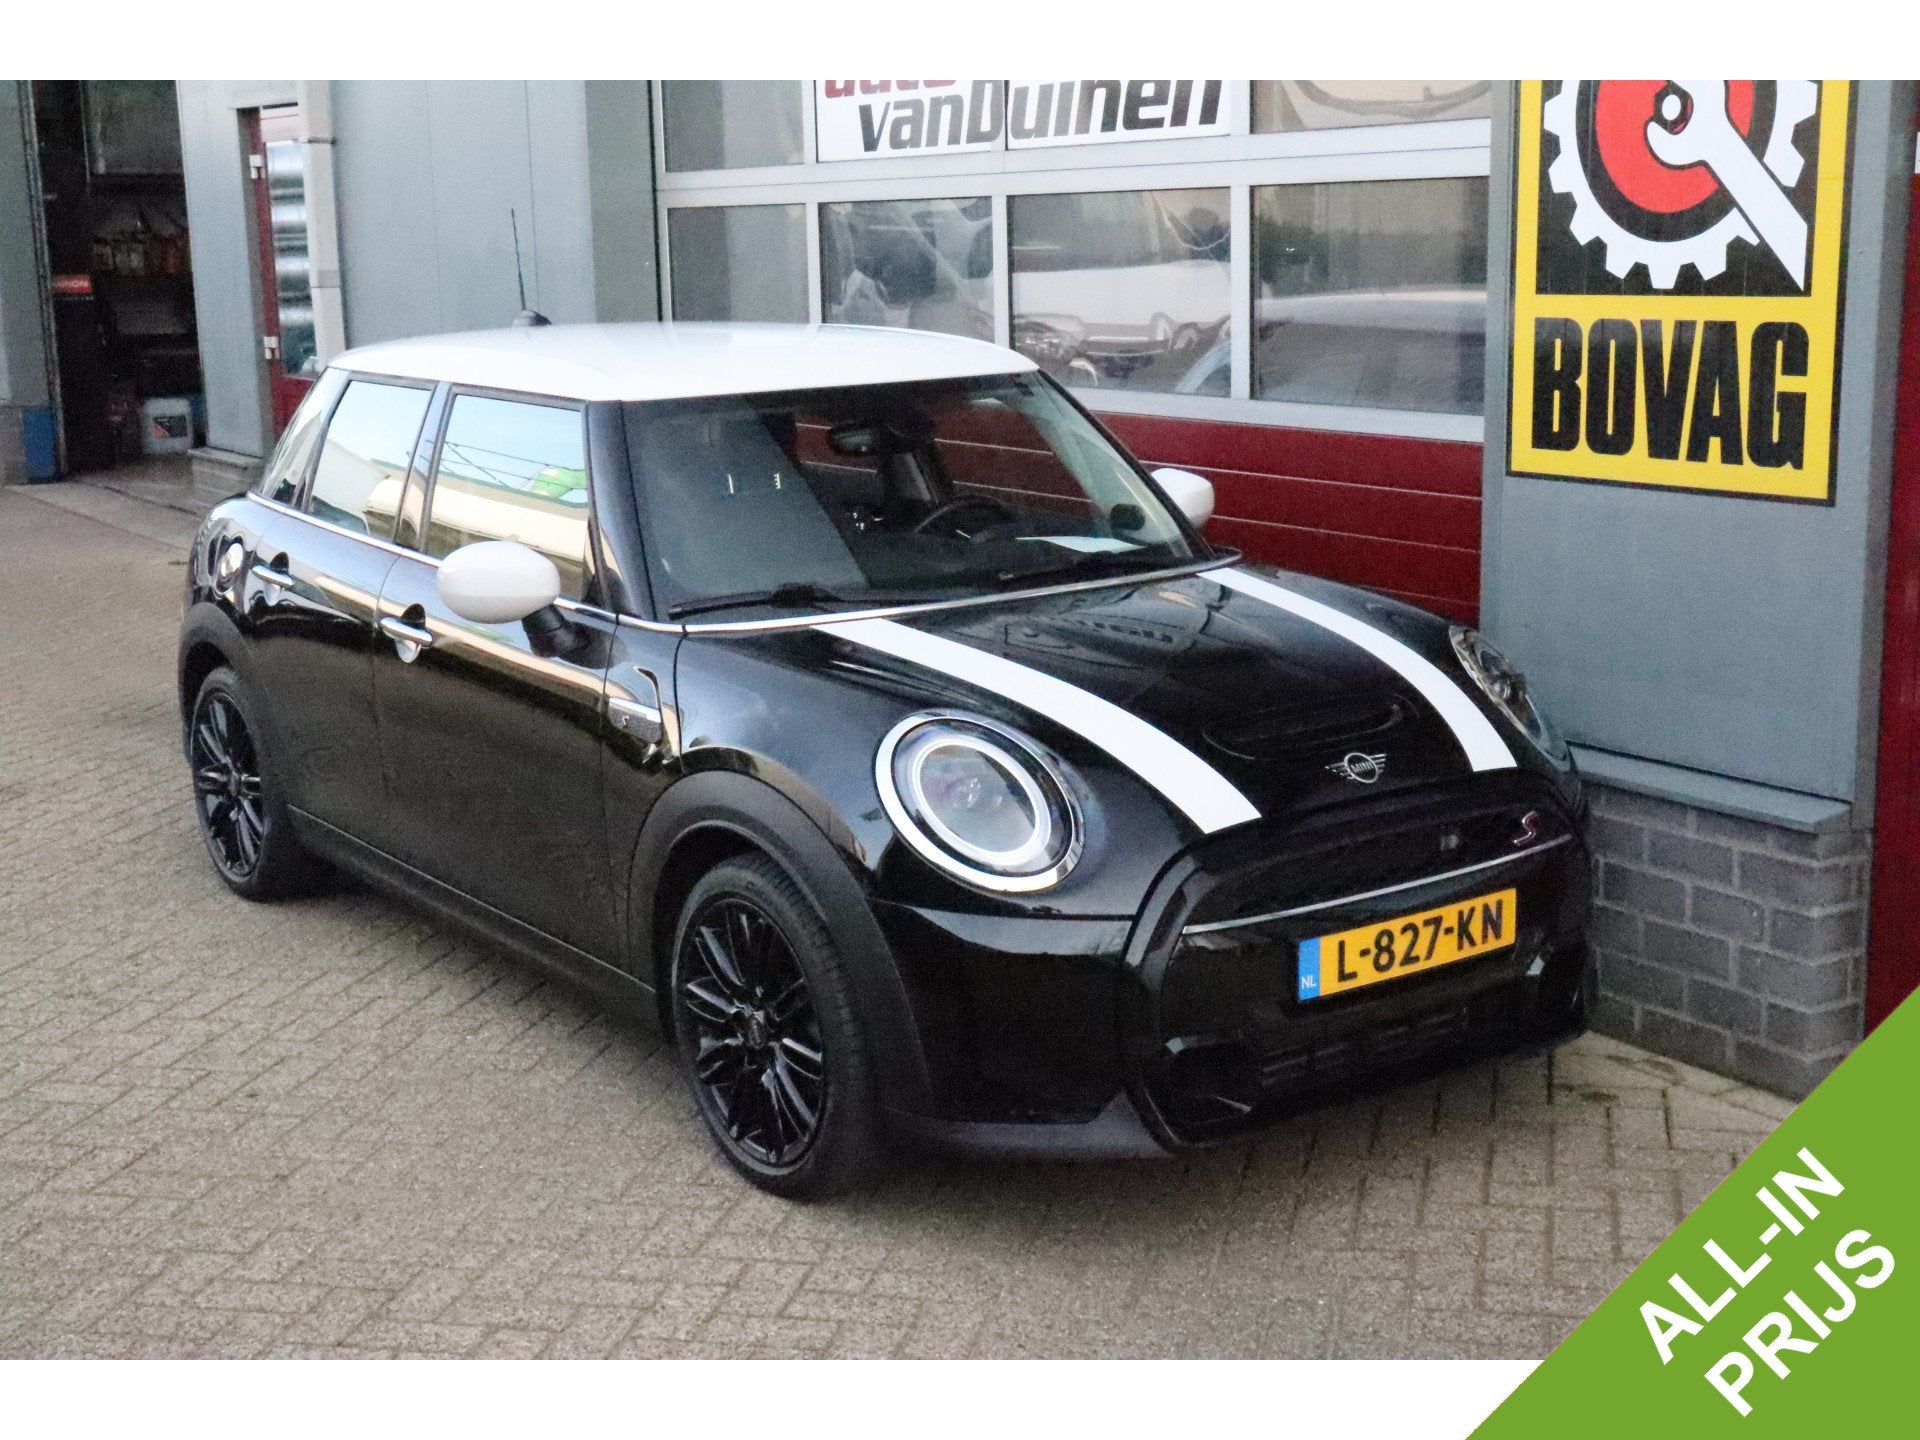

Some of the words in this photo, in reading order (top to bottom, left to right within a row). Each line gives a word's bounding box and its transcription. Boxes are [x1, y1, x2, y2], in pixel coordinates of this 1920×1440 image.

[1531, 317, 1809, 470] BOVAG
[1350, 761, 1374, 773] MINI
[1513, 810, 1538, 847] S
[1337, 899, 1503, 983] L-827-KN
[1301, 976, 1317, 989] NL
